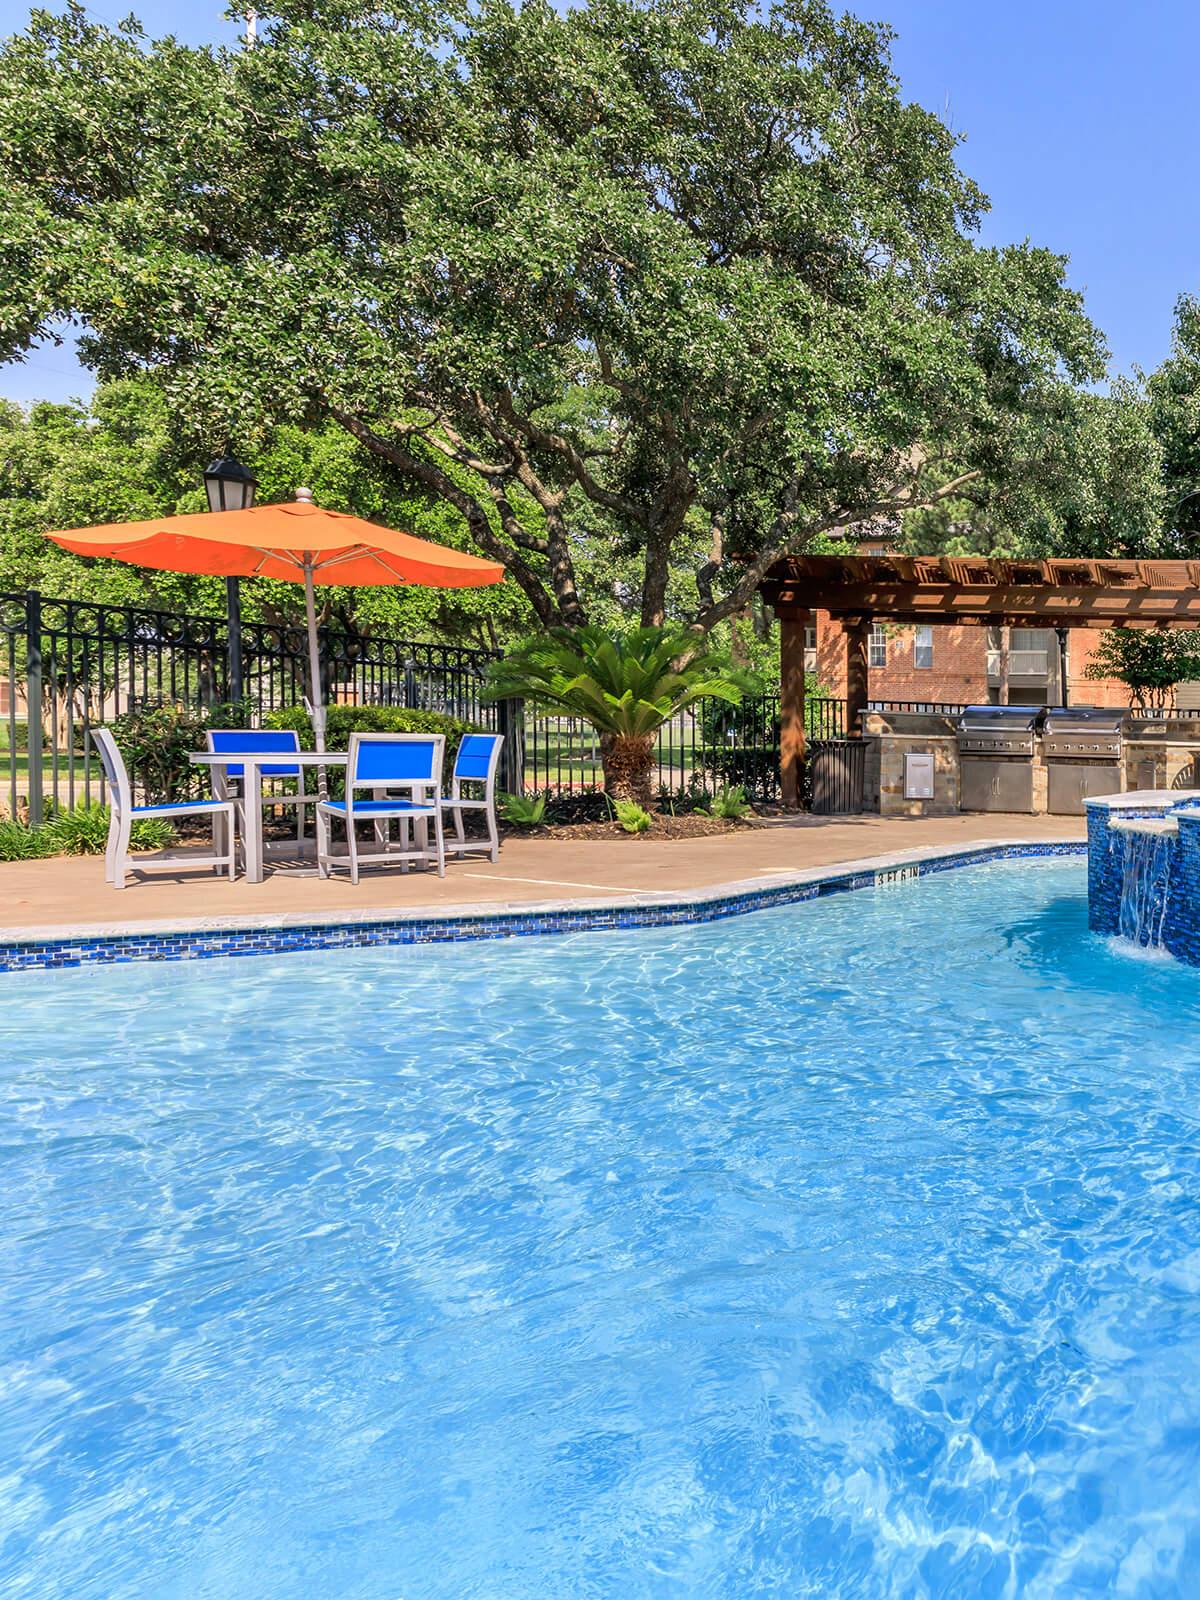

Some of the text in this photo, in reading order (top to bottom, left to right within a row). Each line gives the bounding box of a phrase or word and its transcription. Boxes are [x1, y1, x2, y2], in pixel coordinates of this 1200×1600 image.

[878, 872, 884, 885] 3
[887, 870, 897, 882] FT
[910, 866, 918, 878] IN
